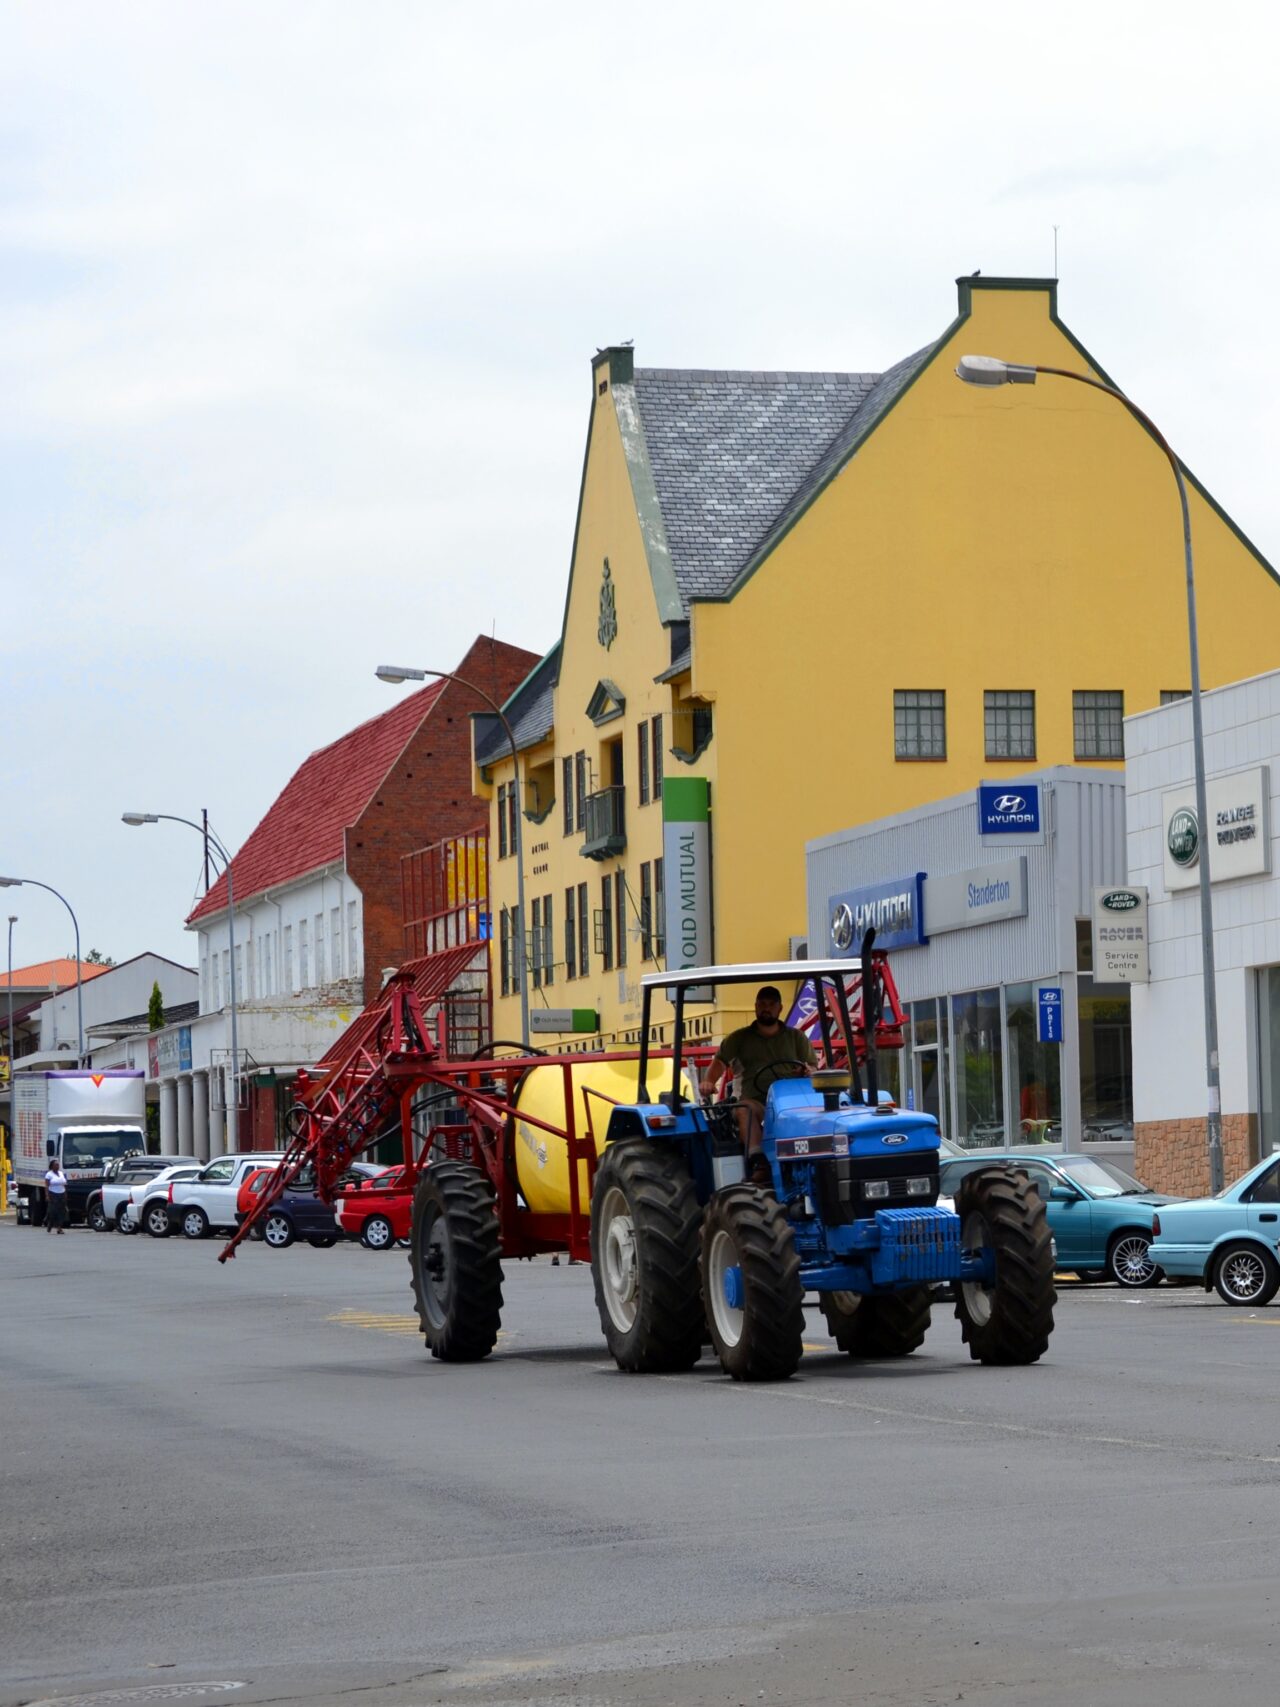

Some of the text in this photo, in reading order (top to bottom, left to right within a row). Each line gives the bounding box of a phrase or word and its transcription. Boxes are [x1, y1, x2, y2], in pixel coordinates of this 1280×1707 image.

[988, 814, 1034, 823] HYUNDAI
[1216, 804, 1256, 826] RANGE
[1217, 824, 1257, 846] ROVER
[679, 831, 698, 958] OLD MUTUAL
[968, 880, 1010, 908] Standerton
[855, 892, 912, 941] HYUNDAI
[1105, 952, 1139, 960] Service
[1108, 961, 1137, 969] Centre
[682, 1015, 713, 1040] UTUAL
